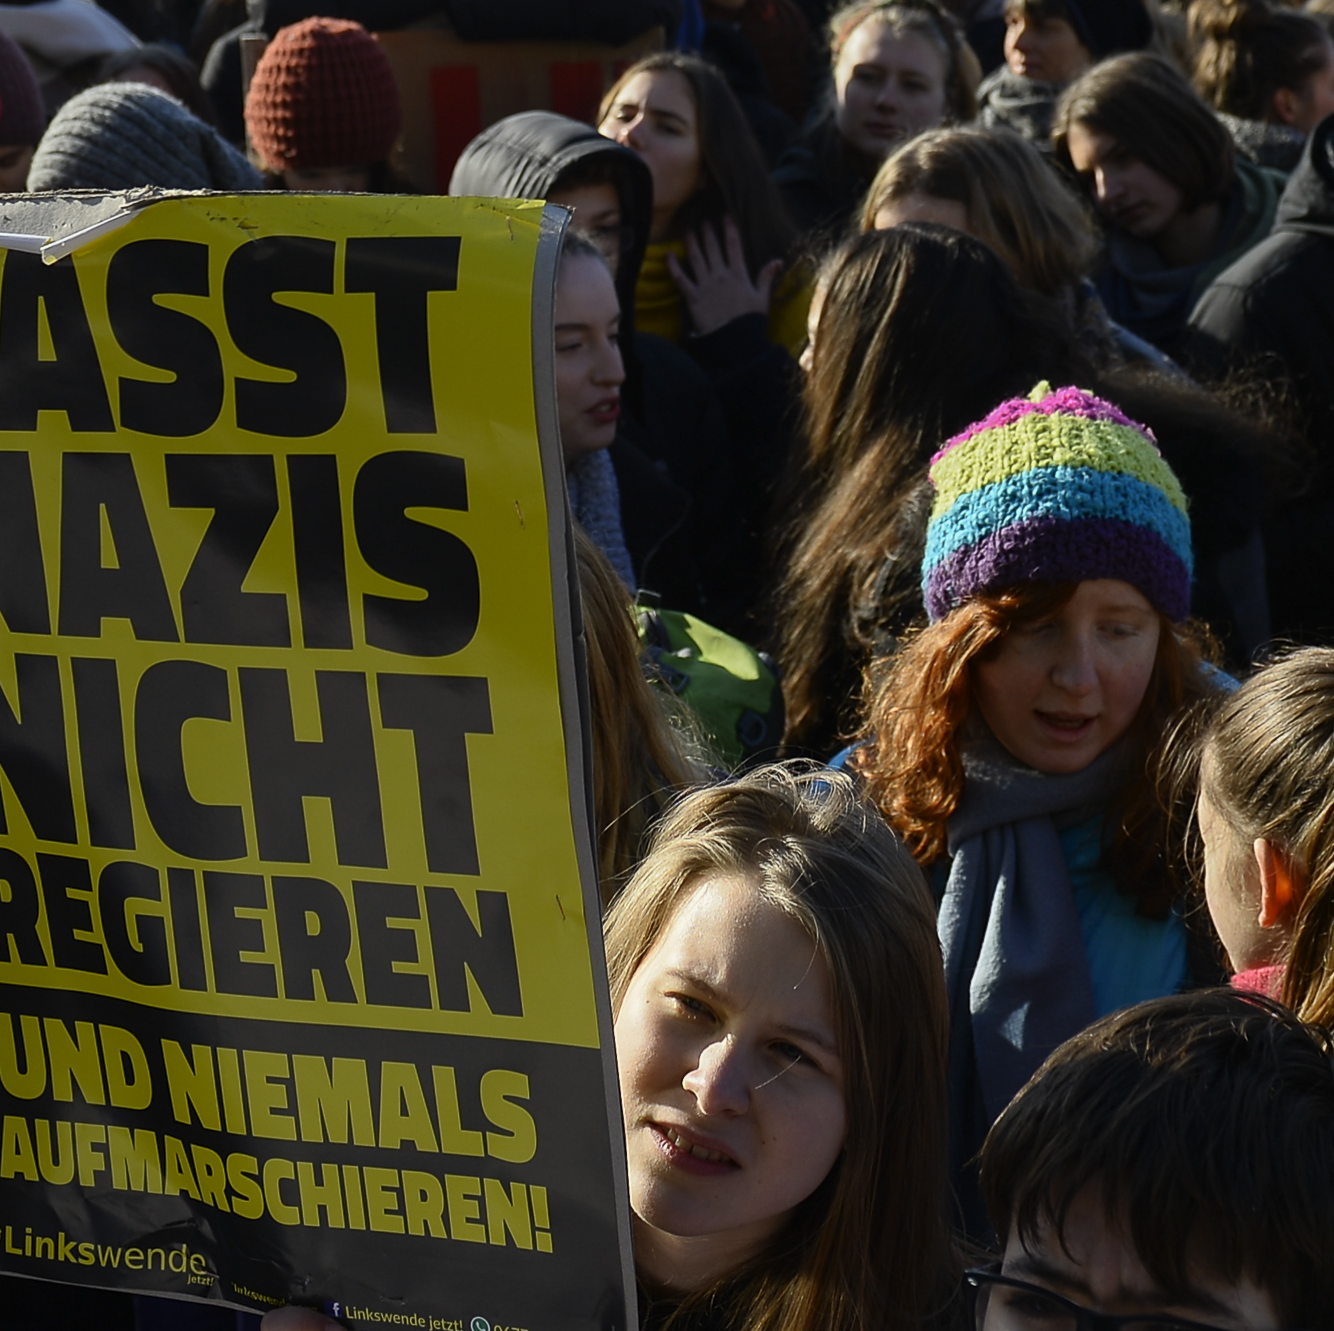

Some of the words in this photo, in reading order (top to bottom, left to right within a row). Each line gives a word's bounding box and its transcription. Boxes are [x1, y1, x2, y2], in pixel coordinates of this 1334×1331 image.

[160, 1039, 538, 1165] NIEMALS
[0, 1115, 554, 1254] AUFMARSCHIEREN!
[4, 1225, 208, 1275] Linkswende
[186, 1273, 215, 1288] jetzt!
[345, 1306, 426, 1328] Linkswende
[428, 1315, 463, 1331] jetzt!
